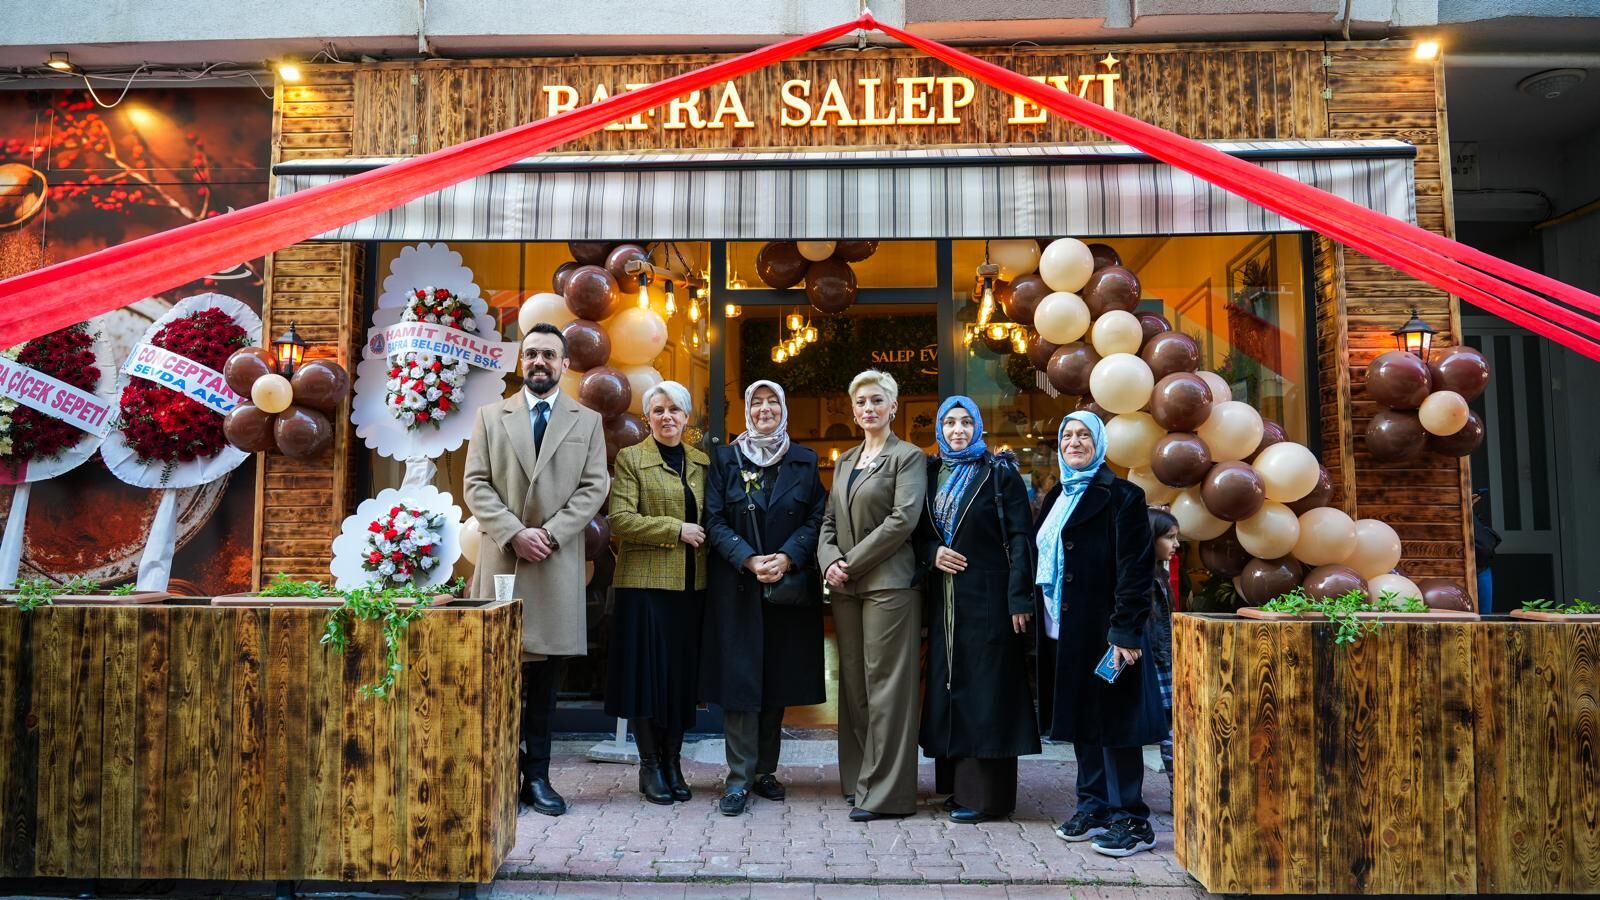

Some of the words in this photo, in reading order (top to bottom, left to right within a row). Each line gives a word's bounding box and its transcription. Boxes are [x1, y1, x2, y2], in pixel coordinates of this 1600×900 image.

[780, 76, 975, 126] SALEP
[386, 325, 439, 341] HAMİT
[388, 339, 408, 353] BAFRA
[411, 338, 471, 360] BELEDİYE
[473, 352, 502, 369] BŞK.
[871, 350, 915, 363] SALEP
[133, 363, 186, 390] SEVDA
[5, 370, 56, 405] ÇİÇEK
[51, 389, 110, 427] SEPETİ
